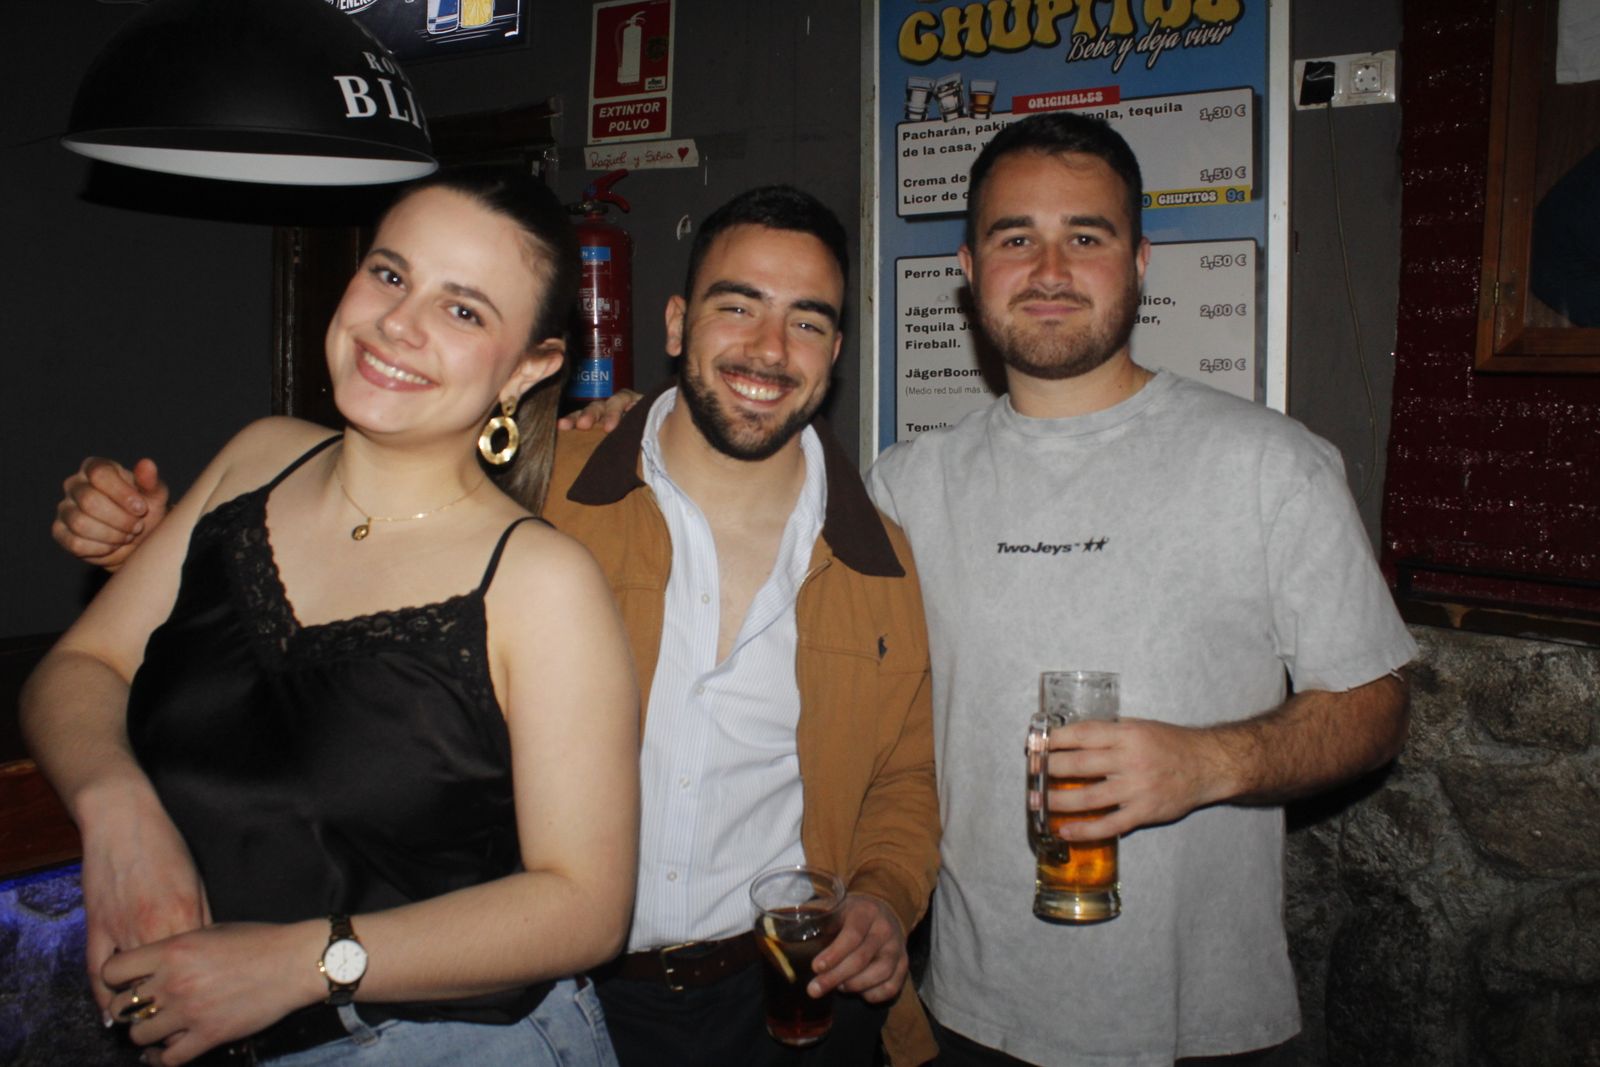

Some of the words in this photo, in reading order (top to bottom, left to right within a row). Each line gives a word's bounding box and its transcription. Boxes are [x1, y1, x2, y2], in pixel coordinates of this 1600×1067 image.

[1067, 26, 1117, 62] Bebe
[1112, 36, 1134, 73] y
[1136, 18, 1181, 69] deja
[1184, 21, 1233, 48] vivir
[361, 51, 402, 78] RO
[333, 75, 430, 140] BLI
[1028, 91, 1104, 109] ORIGINALES
[599, 102, 661, 118] EXTINTOR
[1200, 107, 1232, 121] 1,30
[1235, 104, 1246, 117] €
[608, 118, 650, 133] POLVO
[903, 126, 970, 141] Pacharán,
[1129, 103, 1183, 117] tequila
[903, 149, 918, 157] de
[923, 146, 935, 155] la
[940, 143, 976, 153] casa,
[903, 177, 946, 187] Crema
[951, 174, 967, 183] de
[1200, 168, 1232, 183] 1,50
[1235, 166, 1246, 179] €
[904, 194, 937, 204] Licor
[941, 191, 957, 201] de
[1158, 190, 1217, 206] CHUPITOS
[1200, 255, 1233, 269] 1,50
[1235, 254, 1247, 267] €
[905, 269, 941, 279] Perro
[1200, 304, 1233, 319] 2,00
[1235, 303, 1246, 316] €
[905, 323, 955, 334] Tequila
[905, 339, 961, 350] Fireball.
[1200, 358, 1233, 373] 2,50
[1234, 358, 1246, 371] €
[905, 386, 931, 398] (Medio
[934, 386, 946, 395] red
[948, 385, 962, 394] bull
